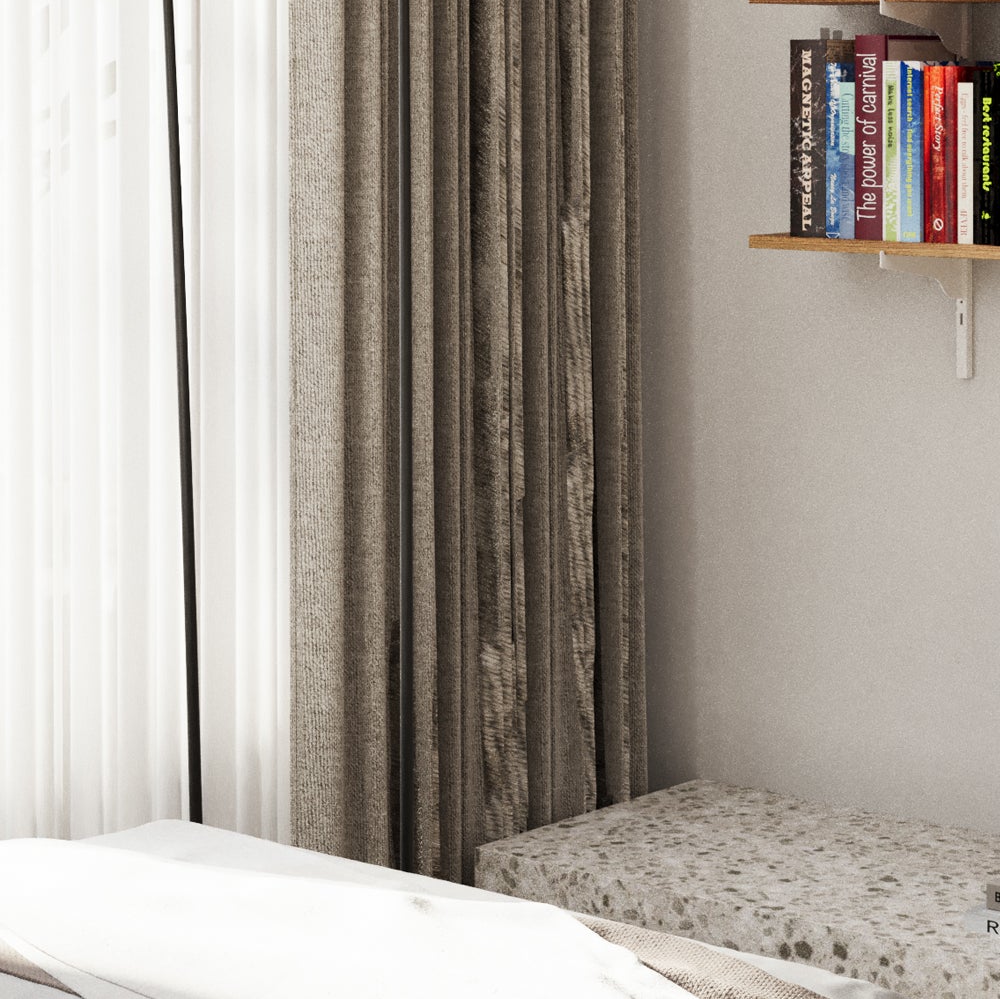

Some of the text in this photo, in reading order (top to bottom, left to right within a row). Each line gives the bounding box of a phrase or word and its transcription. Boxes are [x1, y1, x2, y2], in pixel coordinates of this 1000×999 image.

[801, 50, 812, 231] MAGNETIC APPEAL
[841, 93, 854, 140] Cutting the
[856, 53, 884, 221] The power of carnival
[886, 84, 895, 148] Make less noise
[905, 68, 914, 183] Internet search everything
[932, 86, 943, 152] Perfect Story
[960, 93, 968, 199] Eggs free about them
[982, 97, 992, 191] Best restaurants
